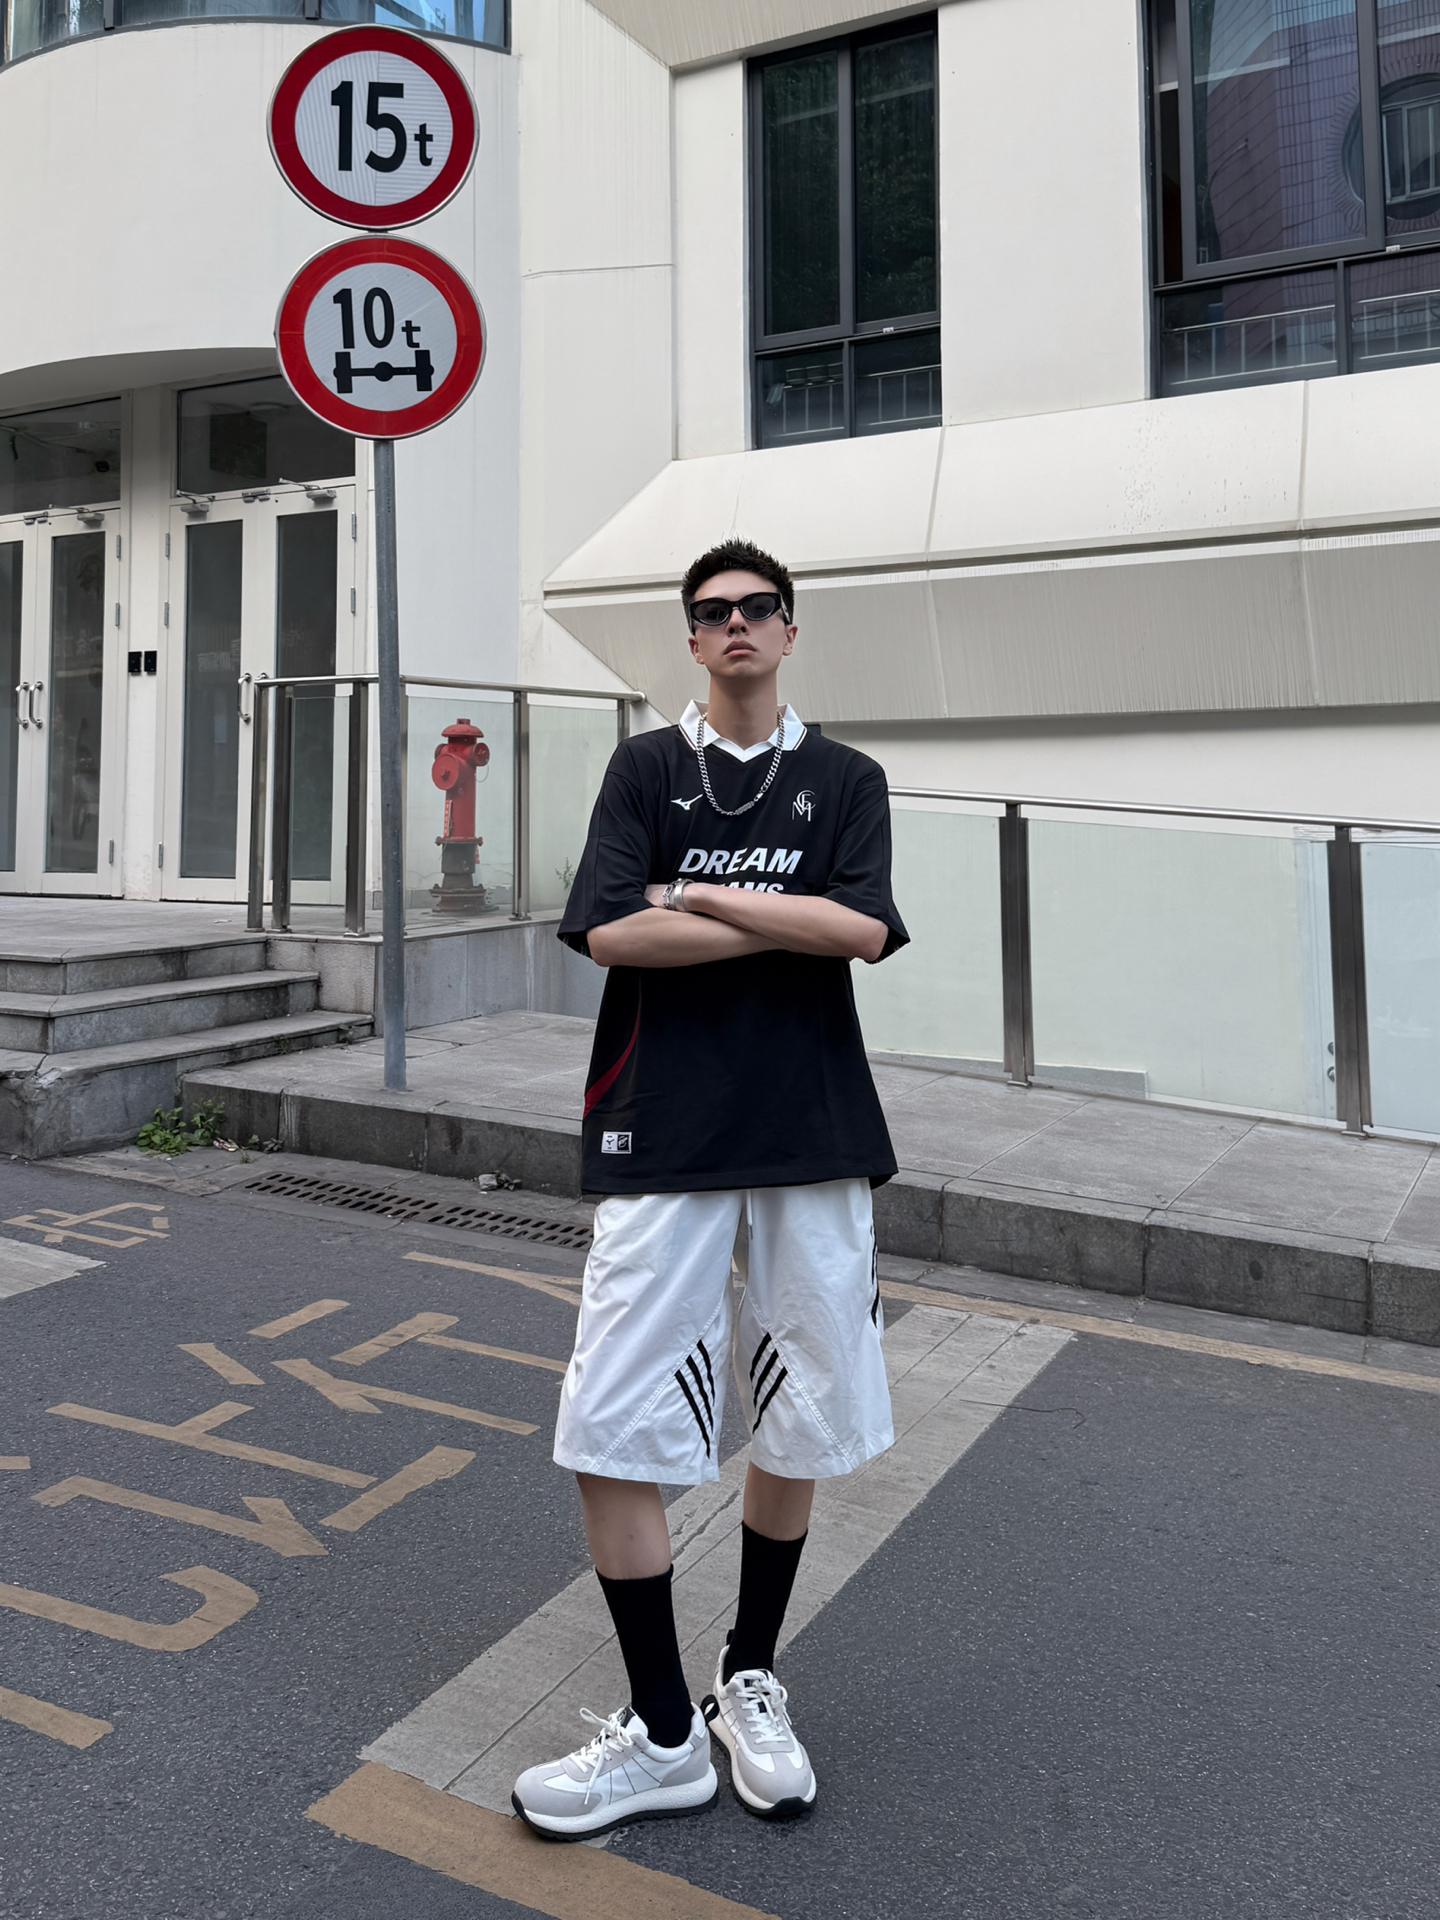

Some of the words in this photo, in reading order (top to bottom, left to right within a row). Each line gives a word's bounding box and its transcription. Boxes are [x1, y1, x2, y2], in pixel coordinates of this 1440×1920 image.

[331, 80, 434, 173] 15t
[333, 287, 421, 349] 10t
[678, 847, 803, 875] DREAM
